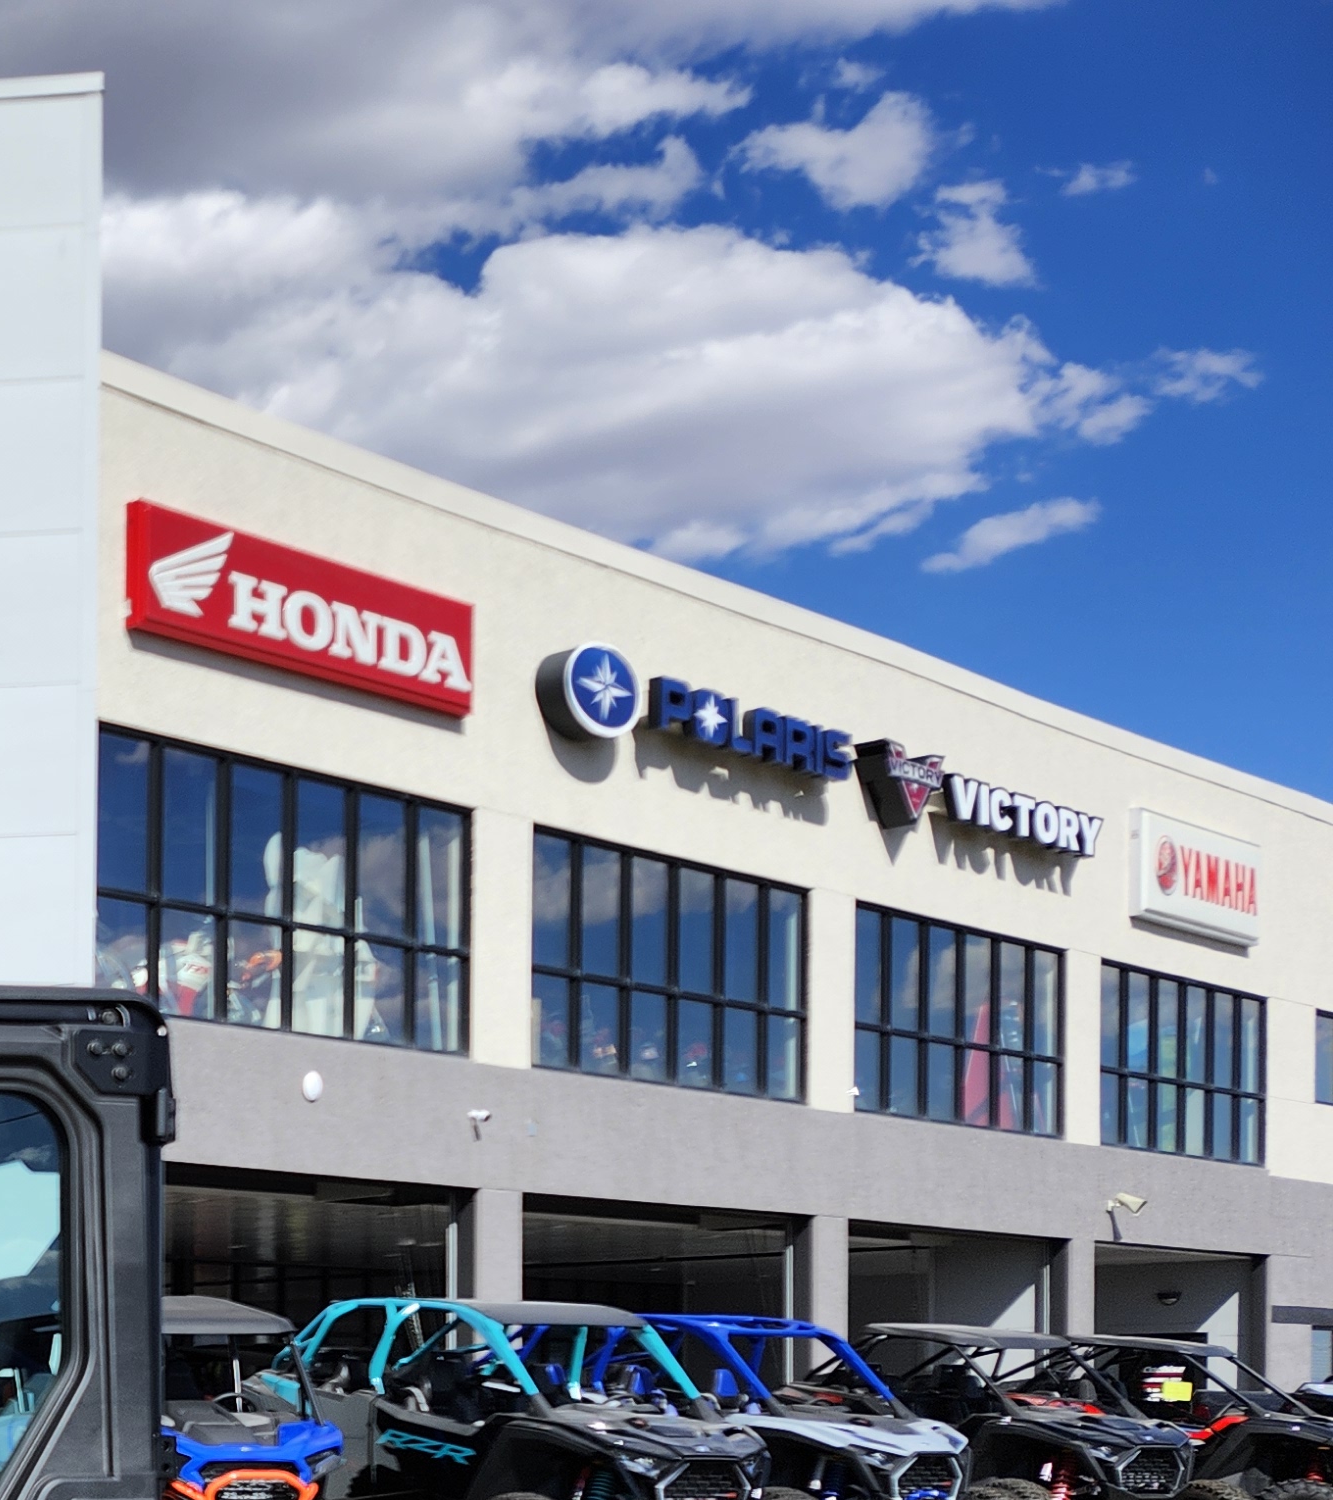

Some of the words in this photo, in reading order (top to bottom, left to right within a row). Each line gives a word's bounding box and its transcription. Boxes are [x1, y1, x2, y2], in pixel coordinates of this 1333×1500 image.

[227, 568, 473, 692] HONDA
[649, 676, 853, 782] POLARIS
[890, 759, 942, 787] VICTORY
[946, 774, 1104, 857] VICTORY
[1180, 846, 1258, 917] YAMAHA
[375, 1428, 477, 1465] RZR
